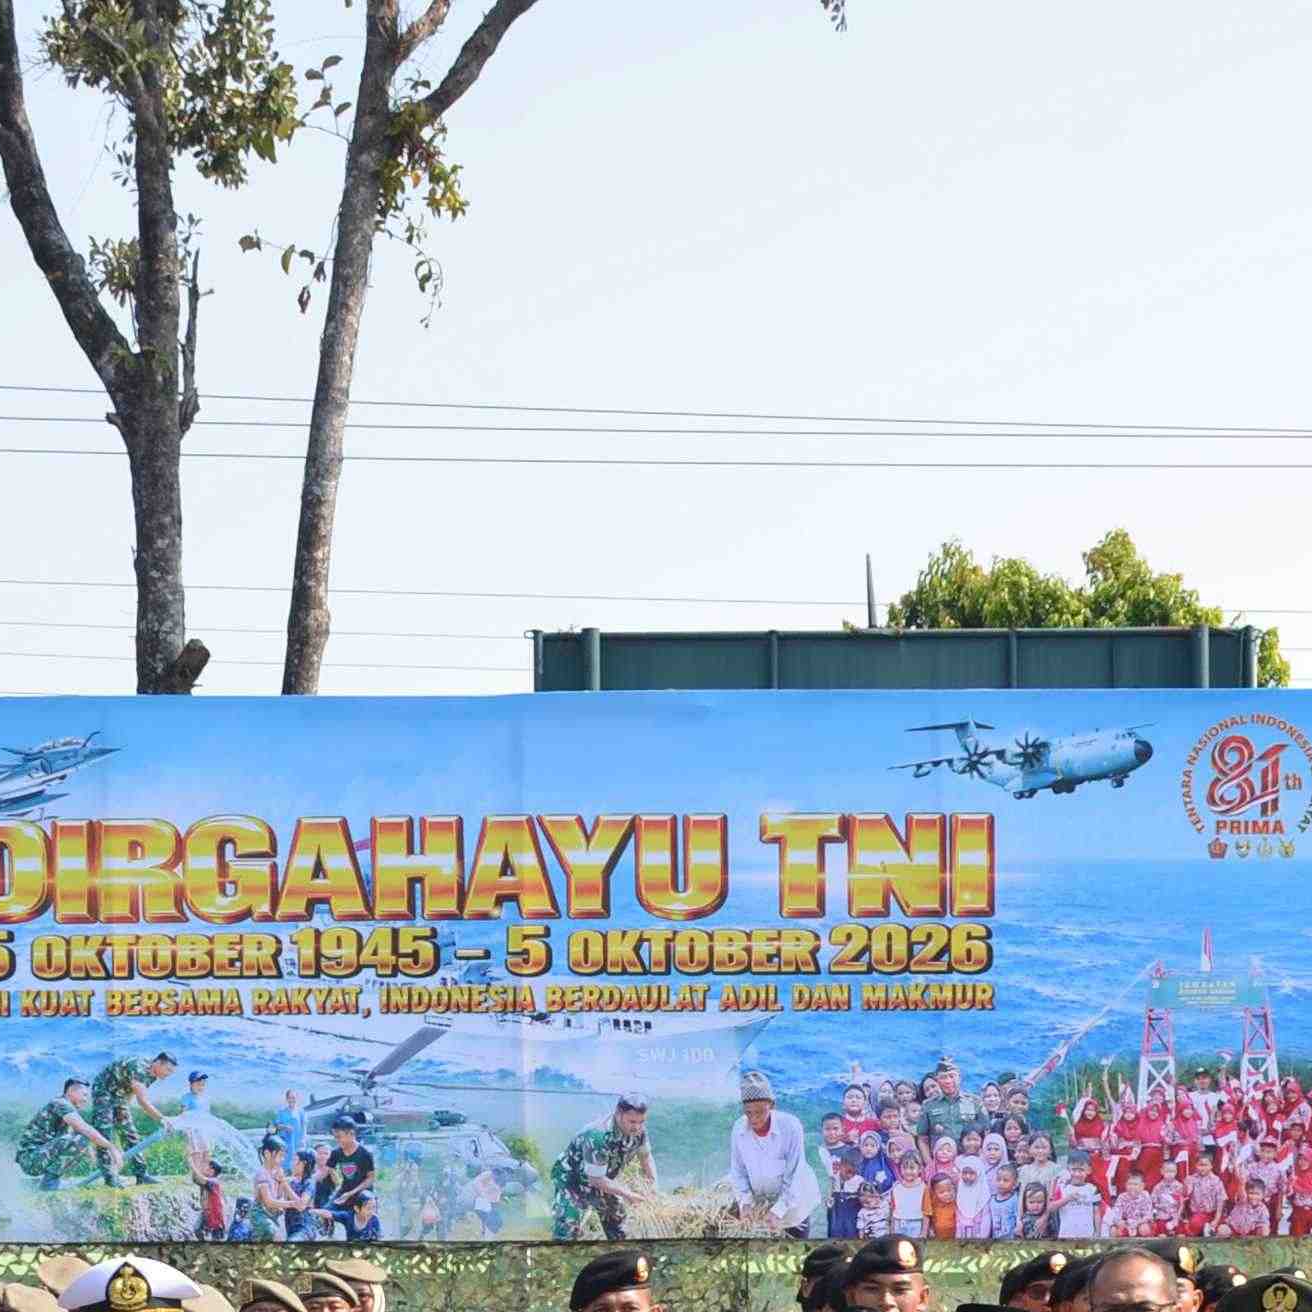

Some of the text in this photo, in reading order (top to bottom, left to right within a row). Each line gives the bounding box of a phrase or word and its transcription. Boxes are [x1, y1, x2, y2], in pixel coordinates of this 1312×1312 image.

[1186, 714, 1249, 766] NASIONAL
[1215, 819, 1286, 835] PRIMA
[759, 812, 995, 919] TNI
[31, 932, 283, 980] OKTOBER
[290, 926, 441, 979] 1945
[504, 923, 552, 977] 5
[568, 927, 820, 976] OKTOBER
[828, 922, 994, 975] 2026
[20, 989, 94, 1017] KUAT
[106, 986, 243, 1016] BERSAMA
[251, 985, 371, 1018] RAKYAT,
[378, 984, 536, 1015] INDONESIA
[545, 983, 711, 1014] BERDAULAT
[719, 984, 784, 1013] ADIL
[792, 983, 852, 1012] DAN
[861, 982, 995, 1012] MAKMUR
